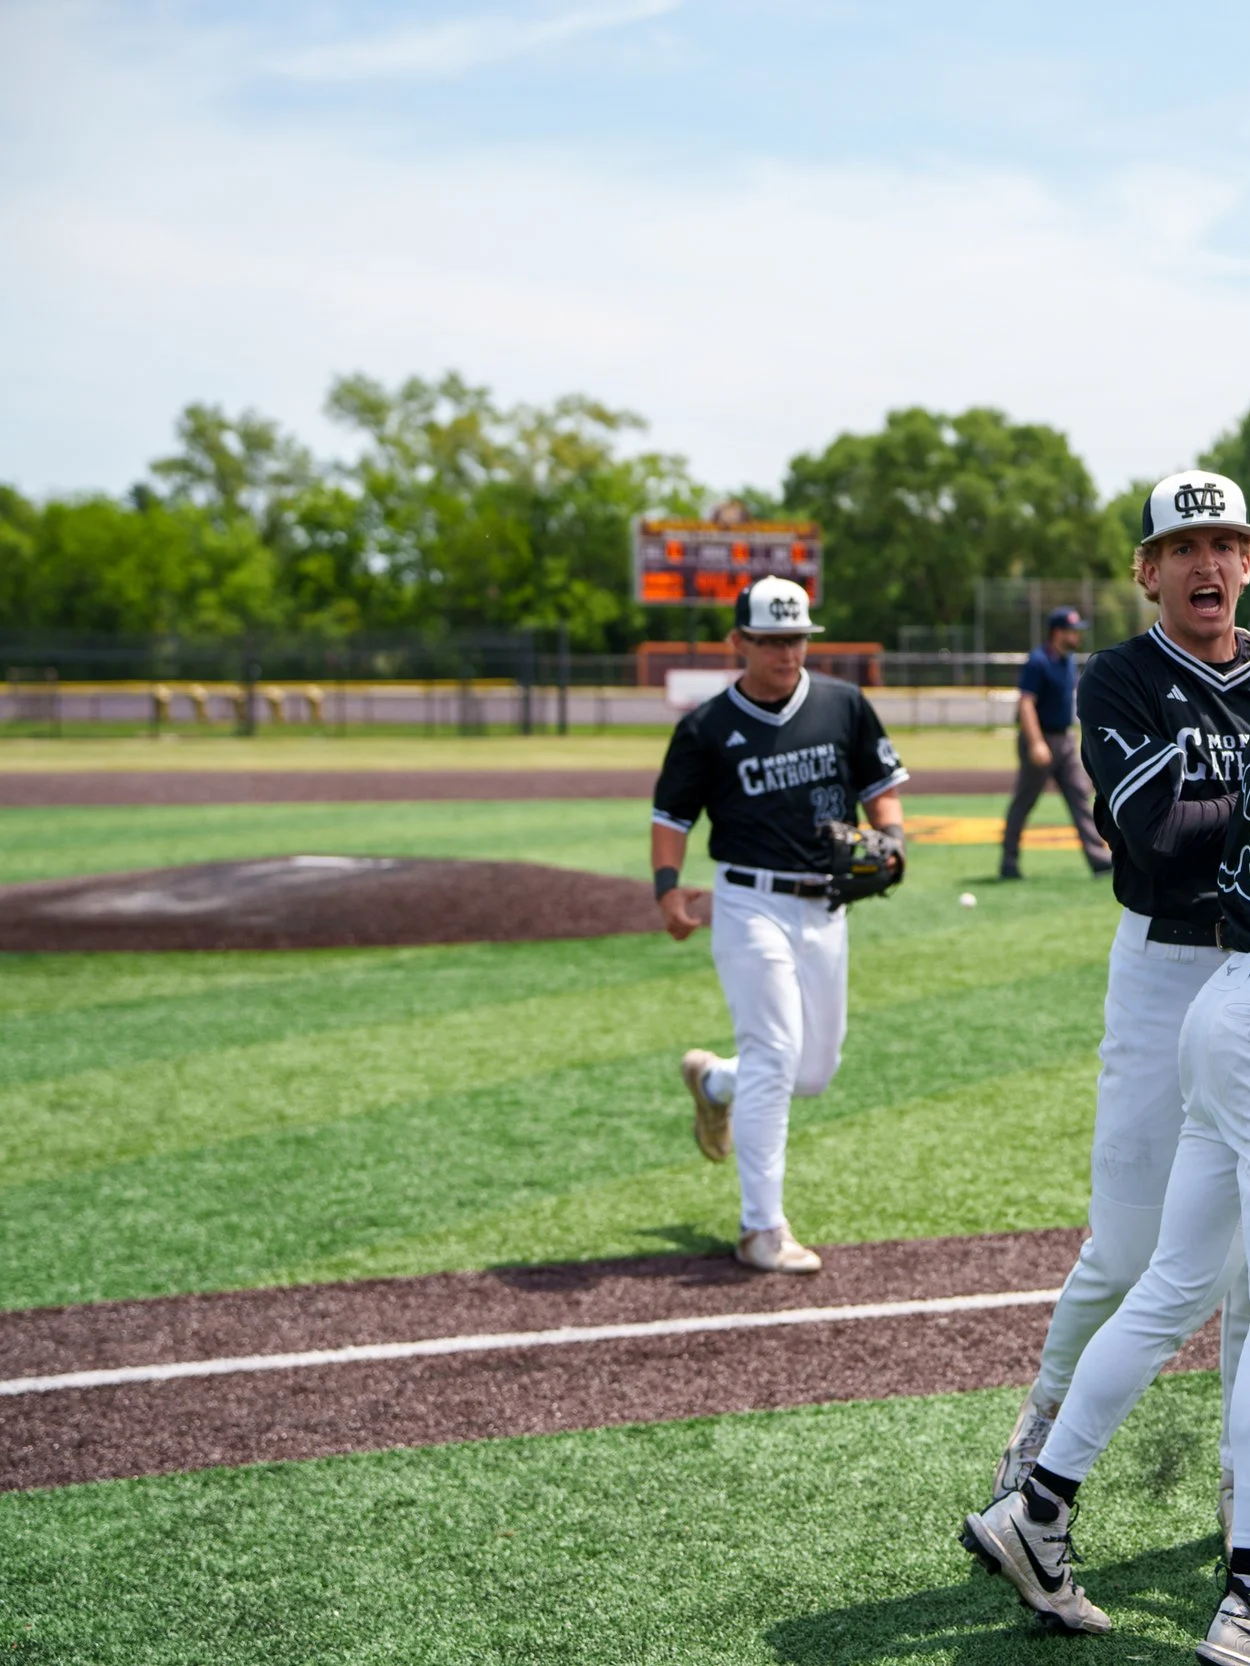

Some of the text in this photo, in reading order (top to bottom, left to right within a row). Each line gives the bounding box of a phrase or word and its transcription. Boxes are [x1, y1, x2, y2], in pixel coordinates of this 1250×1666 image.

[762, 743, 835, 767] MONTINI
[738, 756, 837, 796] CATHOLIC
[811, 785, 846, 827] 23
